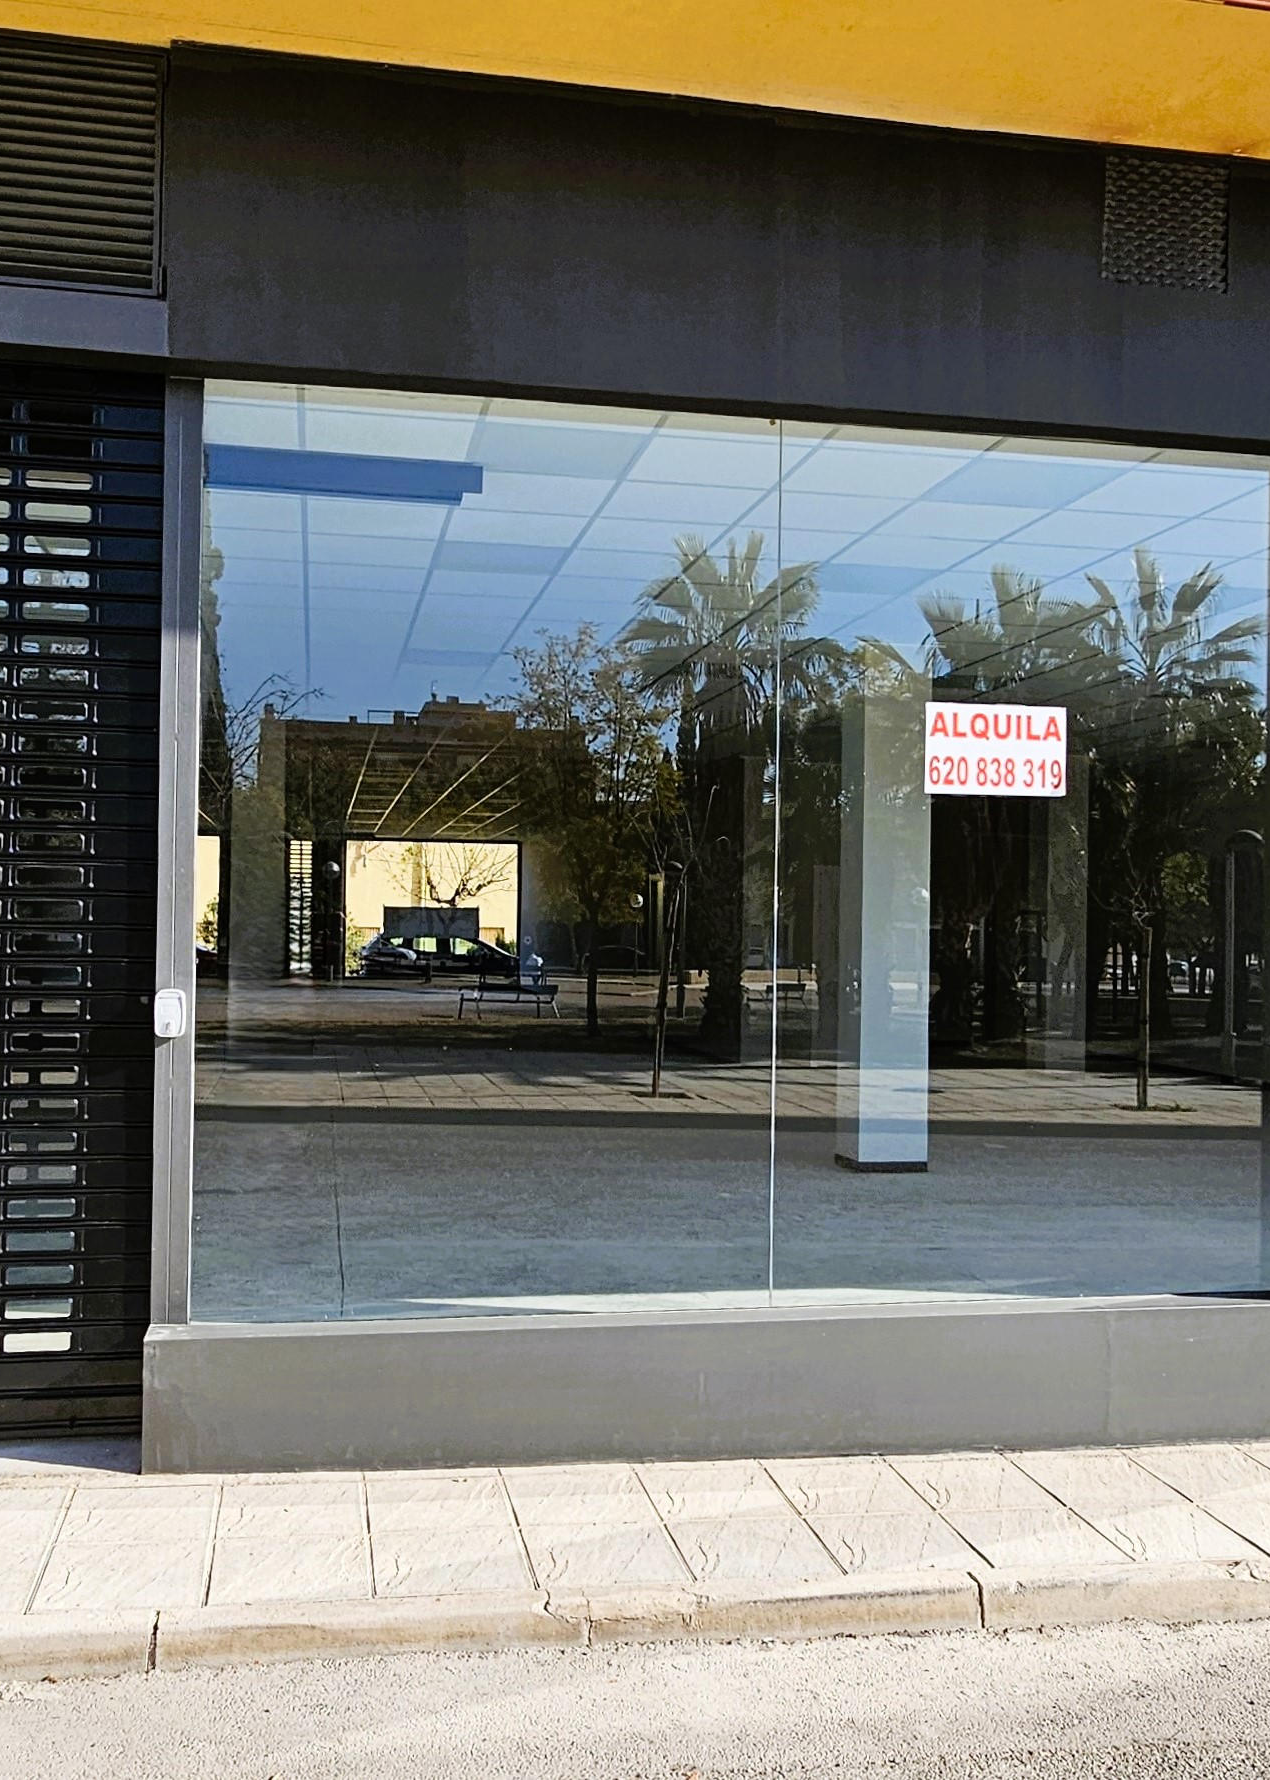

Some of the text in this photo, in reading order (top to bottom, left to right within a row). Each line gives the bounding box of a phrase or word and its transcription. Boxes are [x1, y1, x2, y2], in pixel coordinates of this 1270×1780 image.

[929, 711, 1062, 742] ALQUILA
[929, 755, 1063, 790] 620 838 319
